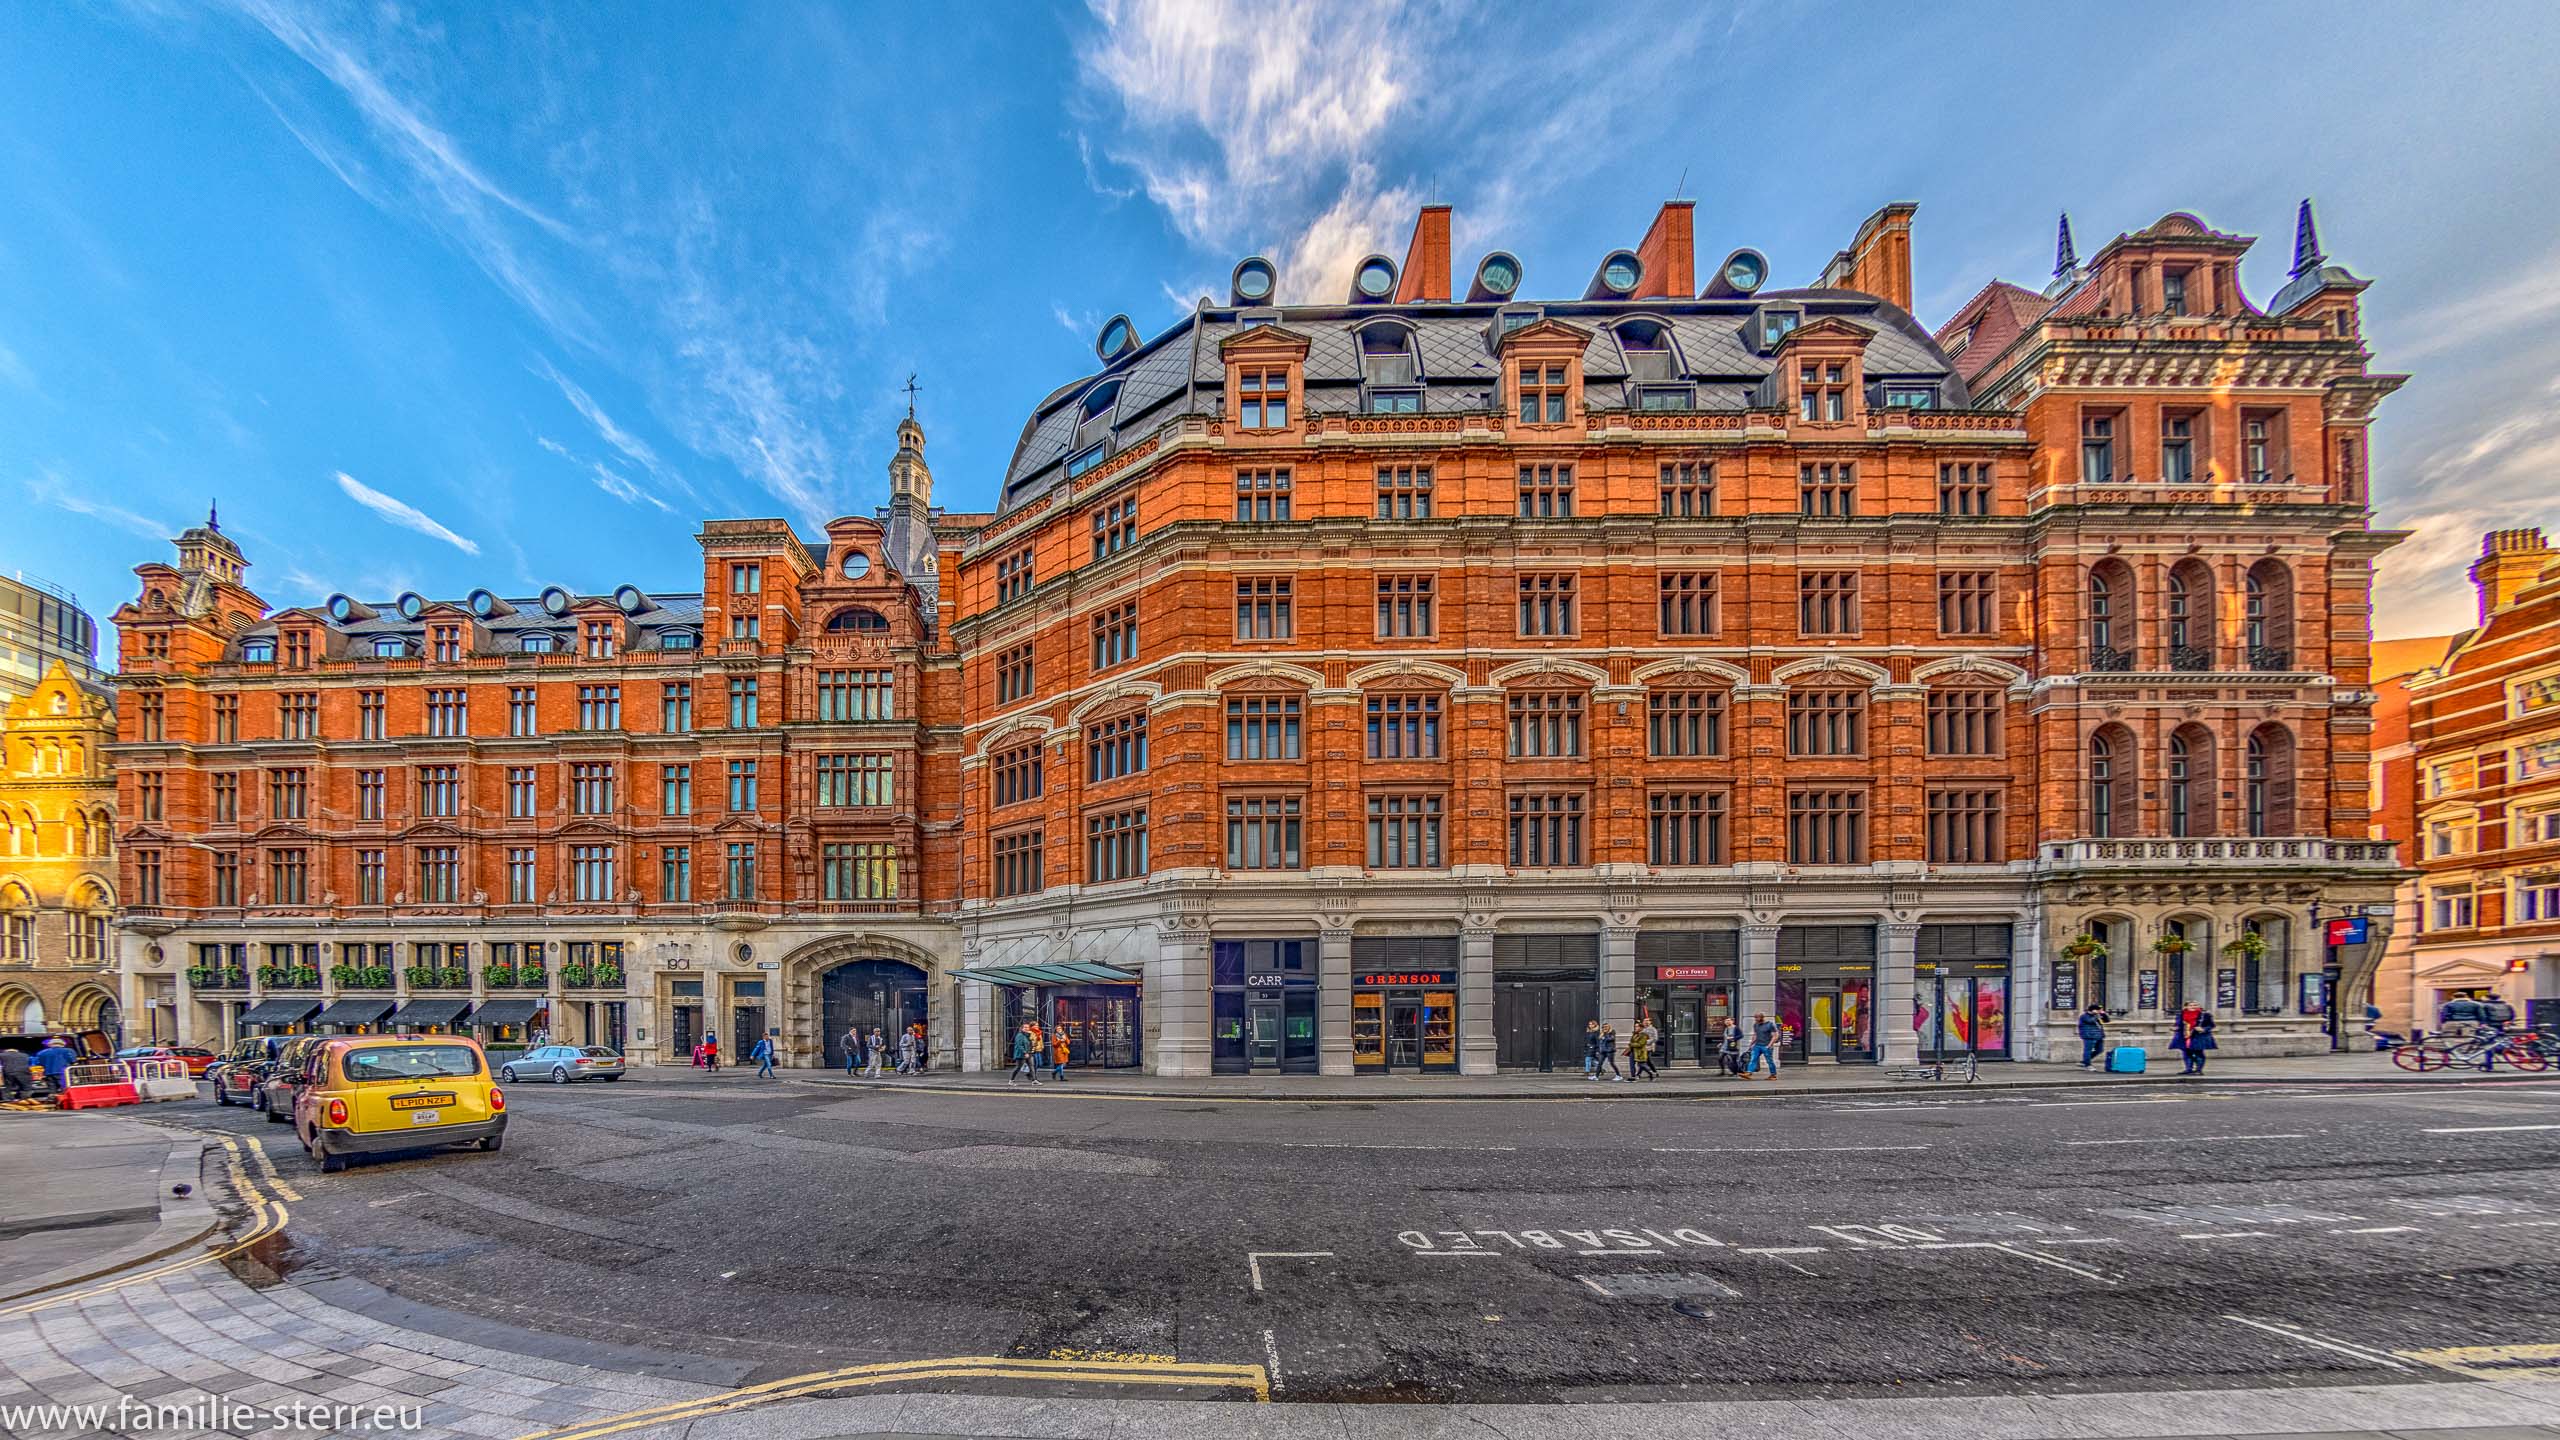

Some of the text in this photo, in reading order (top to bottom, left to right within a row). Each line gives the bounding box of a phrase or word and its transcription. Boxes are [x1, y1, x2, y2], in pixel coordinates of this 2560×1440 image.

[1248, 976, 1282, 985] CARR
[1365, 975, 1440, 984] GRENSON
[401, 1098, 424, 1107] LP10
[1397, 1228, 1727, 1249] DISABLED
